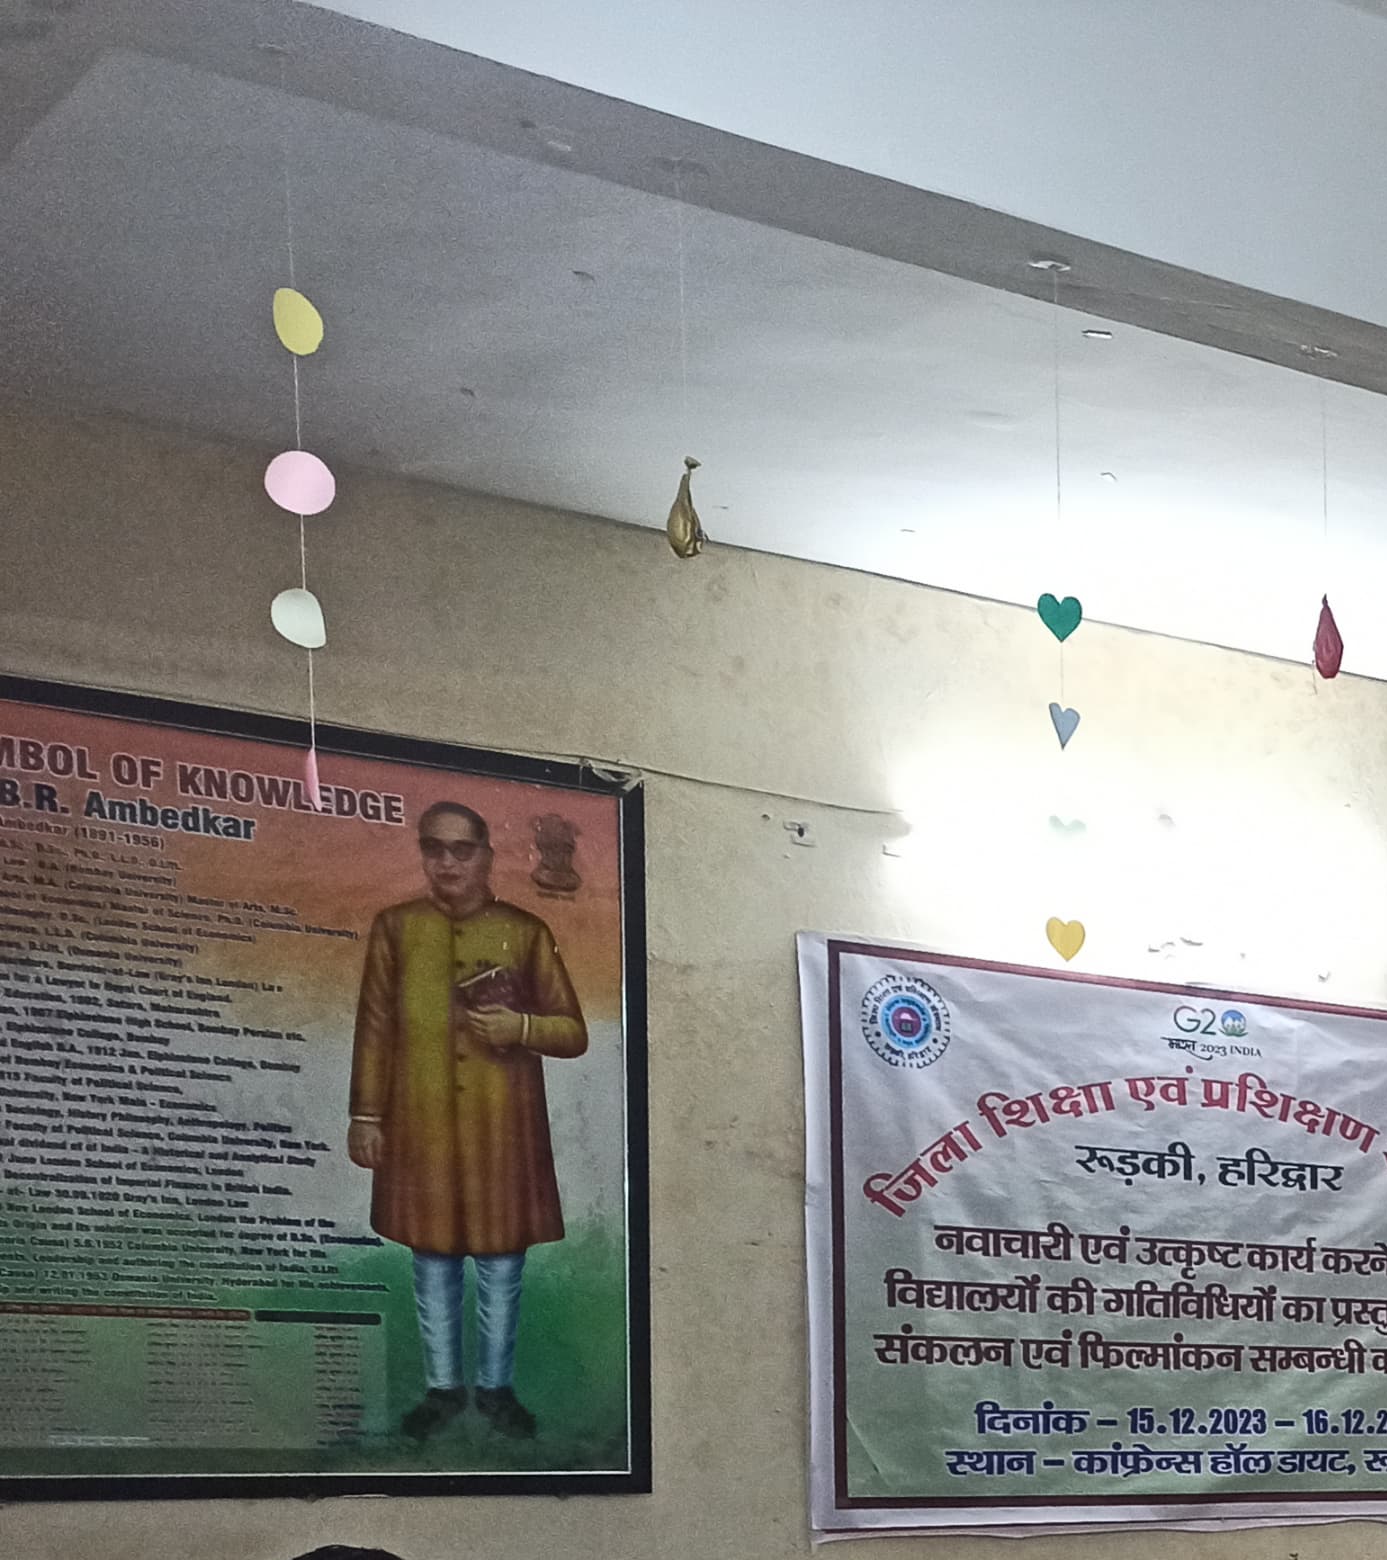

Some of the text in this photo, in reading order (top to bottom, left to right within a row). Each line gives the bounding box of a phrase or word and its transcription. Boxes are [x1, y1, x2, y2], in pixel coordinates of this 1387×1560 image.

[110, 752, 163, 790] OF
[177, 762, 405, 825] KNOWLEDGE
[84, 789, 257, 842] Ambedkar
[1200, 1043, 1227, 1057] 2023
[1230, 1045, 1262, 1058] INDIA
[863, 1120, 982, 1217] जिला
[977, 1081, 1116, 1138] शिक्षा
[1125, 1065, 1194, 1111] एवं
[1201, 1073, 1380, 1153] प्रशिक्षण
[1074, 1141, 1344, 1191] रूड़की, हरिद्वार
[934, 1222, 1073, 1261] नवाचारी
[1079, 1225, 1131, 1265] एवं
[1135, 1237, 1244, 1280] उत्कृष्ट
[1246, 1237, 1316, 1273] कार्य
[884, 1268, 1041, 1313] विद्यालयों
[1046, 1277, 1097, 1315] की
[1101, 1279, 1277, 1322] गतिविधियों
[1281, 1295, 1326, 1323] का
[873, 1323, 1015, 1367] संकलन
[1020, 1329, 1073, 1370] एवं
[1078, 1331, 1244, 1372] फिल्मांकन
[1249, 1339, 1367, 1374] सम्बन्धी
[974, 1401, 1090, 1435] दिनांक
[1127, 1409, 1268, 1435] 15.12.2023
[945, 1449, 1036, 1476] स्थान
[1072, 1441, 1202, 1476] कांफ्रेन्स
[1208, 1442, 1273, 1475] हॉल
[1277, 1450, 1355, 1476] डायट,
